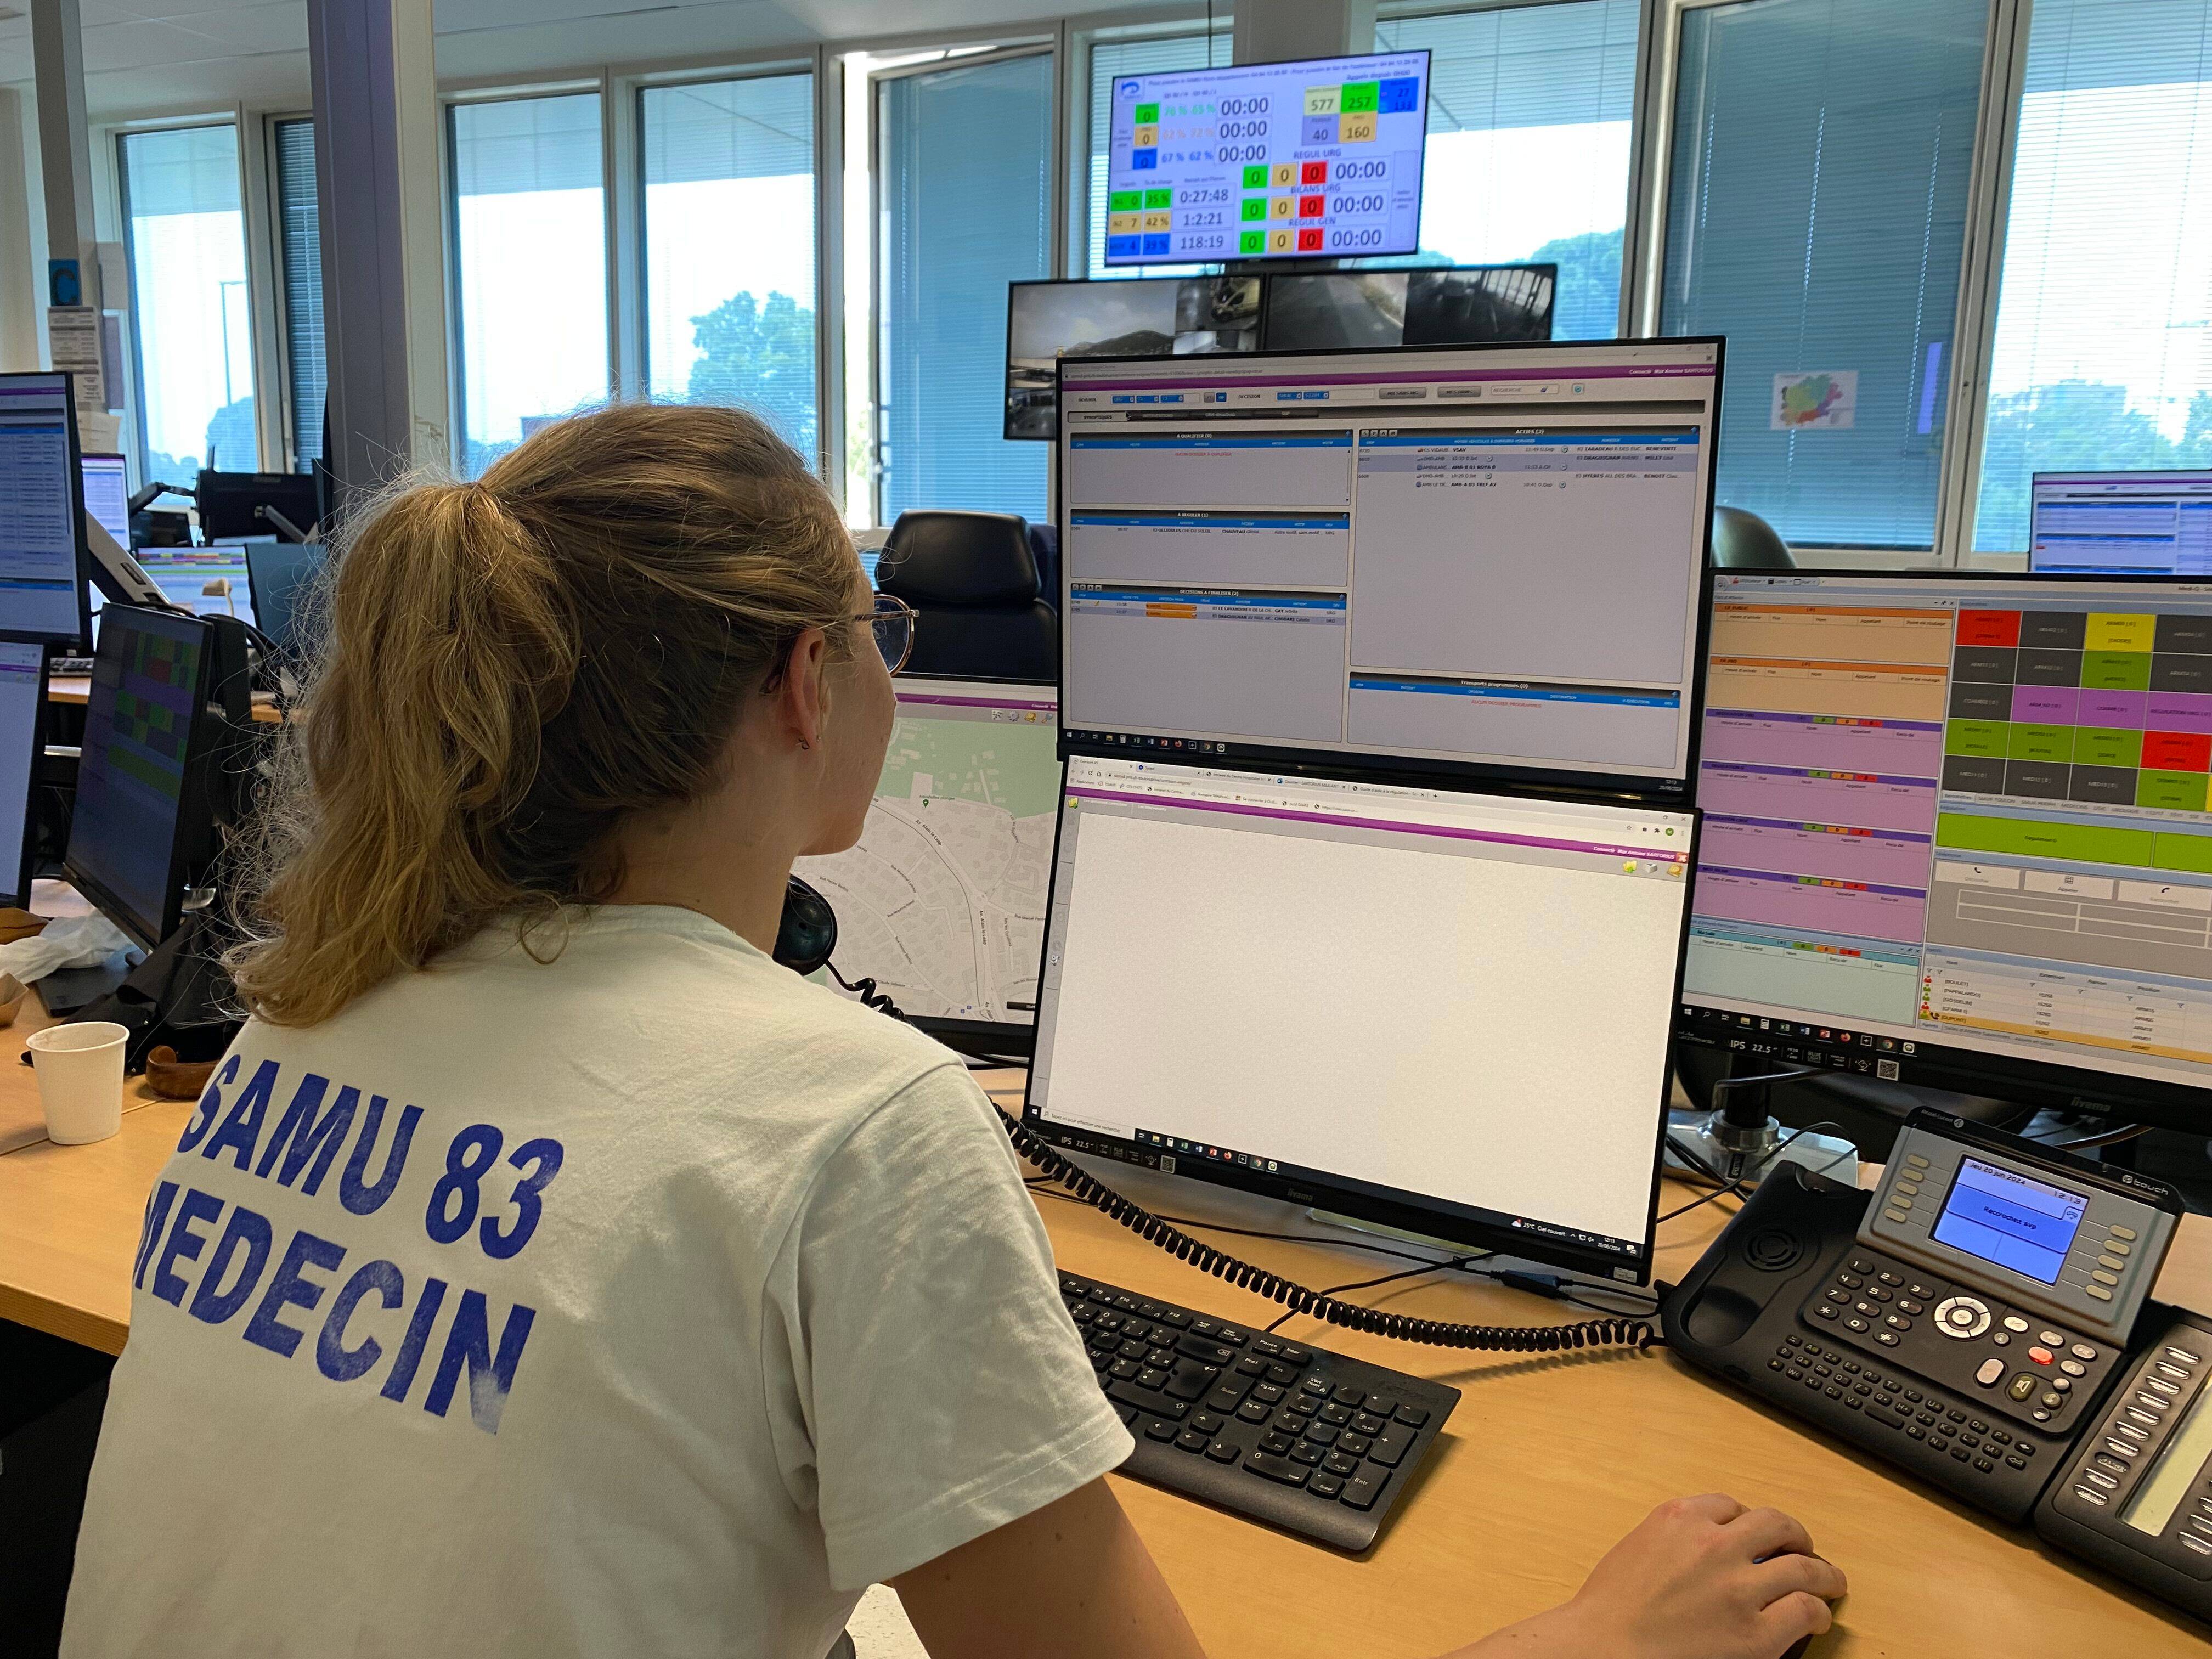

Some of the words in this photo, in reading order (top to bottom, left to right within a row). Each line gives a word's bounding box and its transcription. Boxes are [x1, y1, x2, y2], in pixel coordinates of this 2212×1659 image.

[1221, 97, 1269, 116] 00:00
[1311, 99, 1334, 111] 577
[1348, 97, 1371, 109] 257
[1220, 120, 1267, 138] 00:00
[1313, 129, 1328, 140] 40
[1347, 126, 1370, 139] 160
[1143, 134, 1150, 144] 0
[1219, 144, 1266, 162] 00:00
[1281, 168, 1289, 182] 0
[1310, 166, 1319, 180] 0
[1336, 161, 1386, 179] 00:00
[1252, 171, 1260, 184] 0
[1180, 189, 1228, 203] 0:27:48
[1250, 203, 1258, 216] 0
[1279, 201, 1287, 214] 0
[1308, 200, 1317, 213] 0
[1334, 195, 1384, 213] 00:00
[1184, 212, 1222, 226] 1:2:21
[1181, 236, 1223, 249] 118:19
[1249, 236, 1256, 249] 0
[1278, 234, 1285, 247] 0
[1307, 233, 1316, 246] 0
[1332, 229, 1382, 246] 00:00
[1730, 1040, 1745, 1049] IPS
[178, 1054, 425, 1216] SAMU
[426, 1124, 564, 1260] 83
[1984, 1166, 1993, 1175] 20
[2007, 1175, 2026, 1186] 2024
[2134, 1177, 2168, 1195] touch
[1355, 1477, 1368, 1486] Entr
